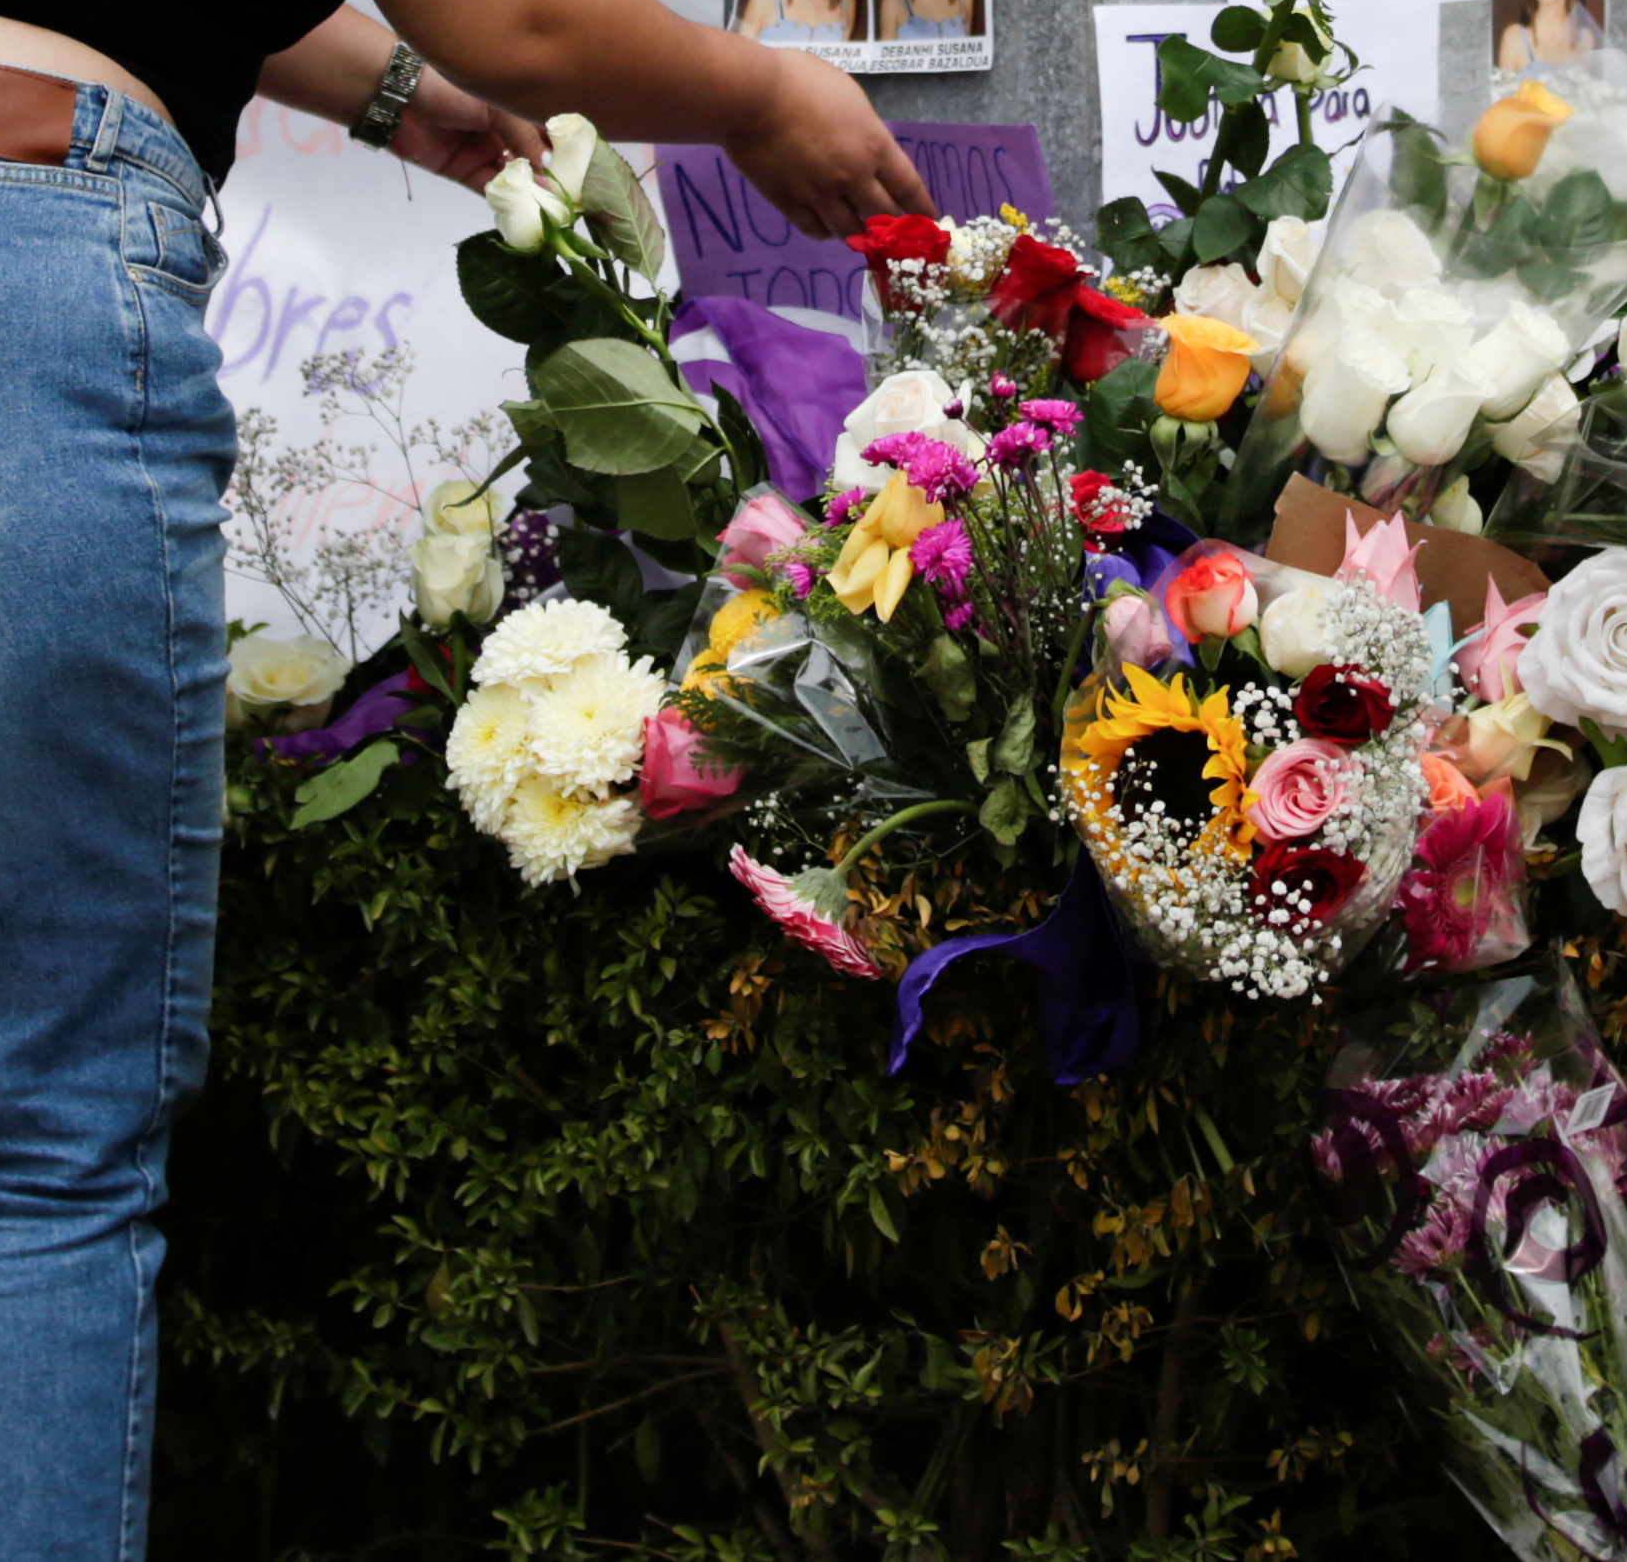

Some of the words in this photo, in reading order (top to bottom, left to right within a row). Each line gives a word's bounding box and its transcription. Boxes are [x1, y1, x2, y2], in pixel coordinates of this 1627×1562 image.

[805, 47, 861, 60] SUSANA
[880, 45, 933, 59] DEBANHI
[936, 43, 984, 57] SUSANA
[869, 59, 925, 72] ESCOBAR
[928, 56, 989, 70] BAZALDUA
[216, 204, 415, 395] bres
